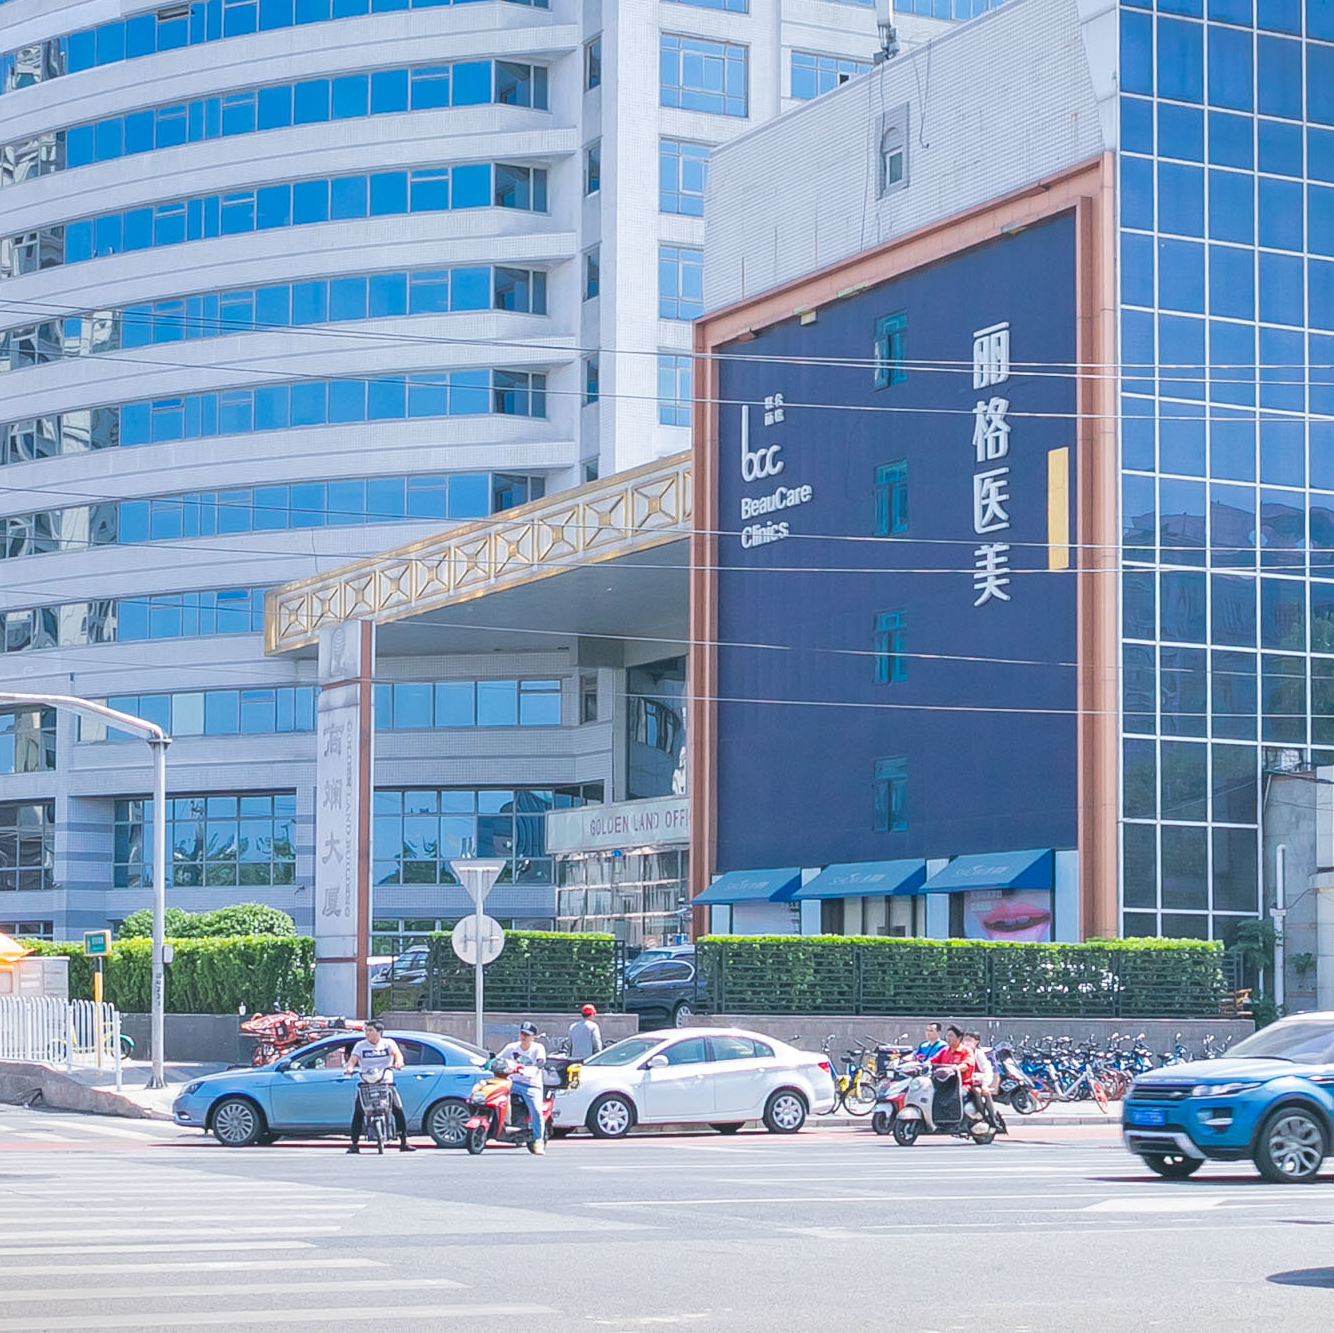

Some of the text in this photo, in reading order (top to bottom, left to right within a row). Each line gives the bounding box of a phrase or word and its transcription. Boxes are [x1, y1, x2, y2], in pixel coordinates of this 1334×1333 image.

[972, 321, 1012, 607] 丽格医美
[741, 484, 813, 520] BeauCare
[741, 520, 791, 549] Clinics
[590, 808, 691, 836] GOLDEN LAND OFFI
